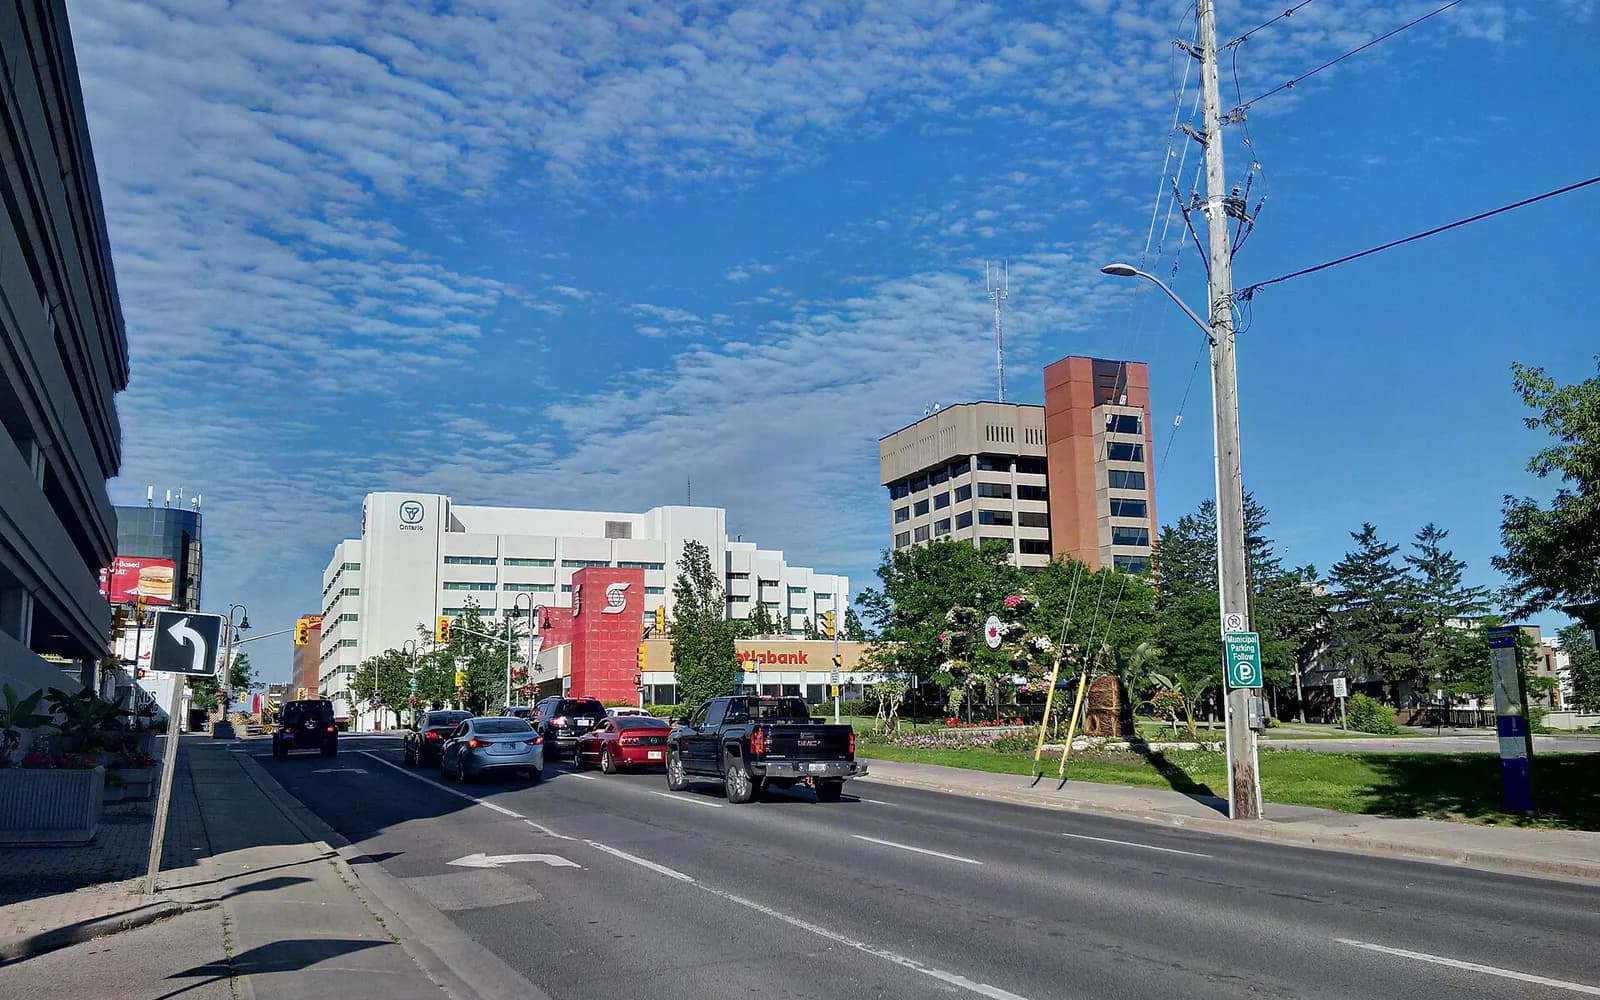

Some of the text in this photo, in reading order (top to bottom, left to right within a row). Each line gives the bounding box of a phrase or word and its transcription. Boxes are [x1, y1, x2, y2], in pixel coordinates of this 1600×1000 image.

[1227, 636, 1257, 645] Municipal
[1231, 644, 1255, 653] Parking
[735, 650, 808, 665] otiabank
